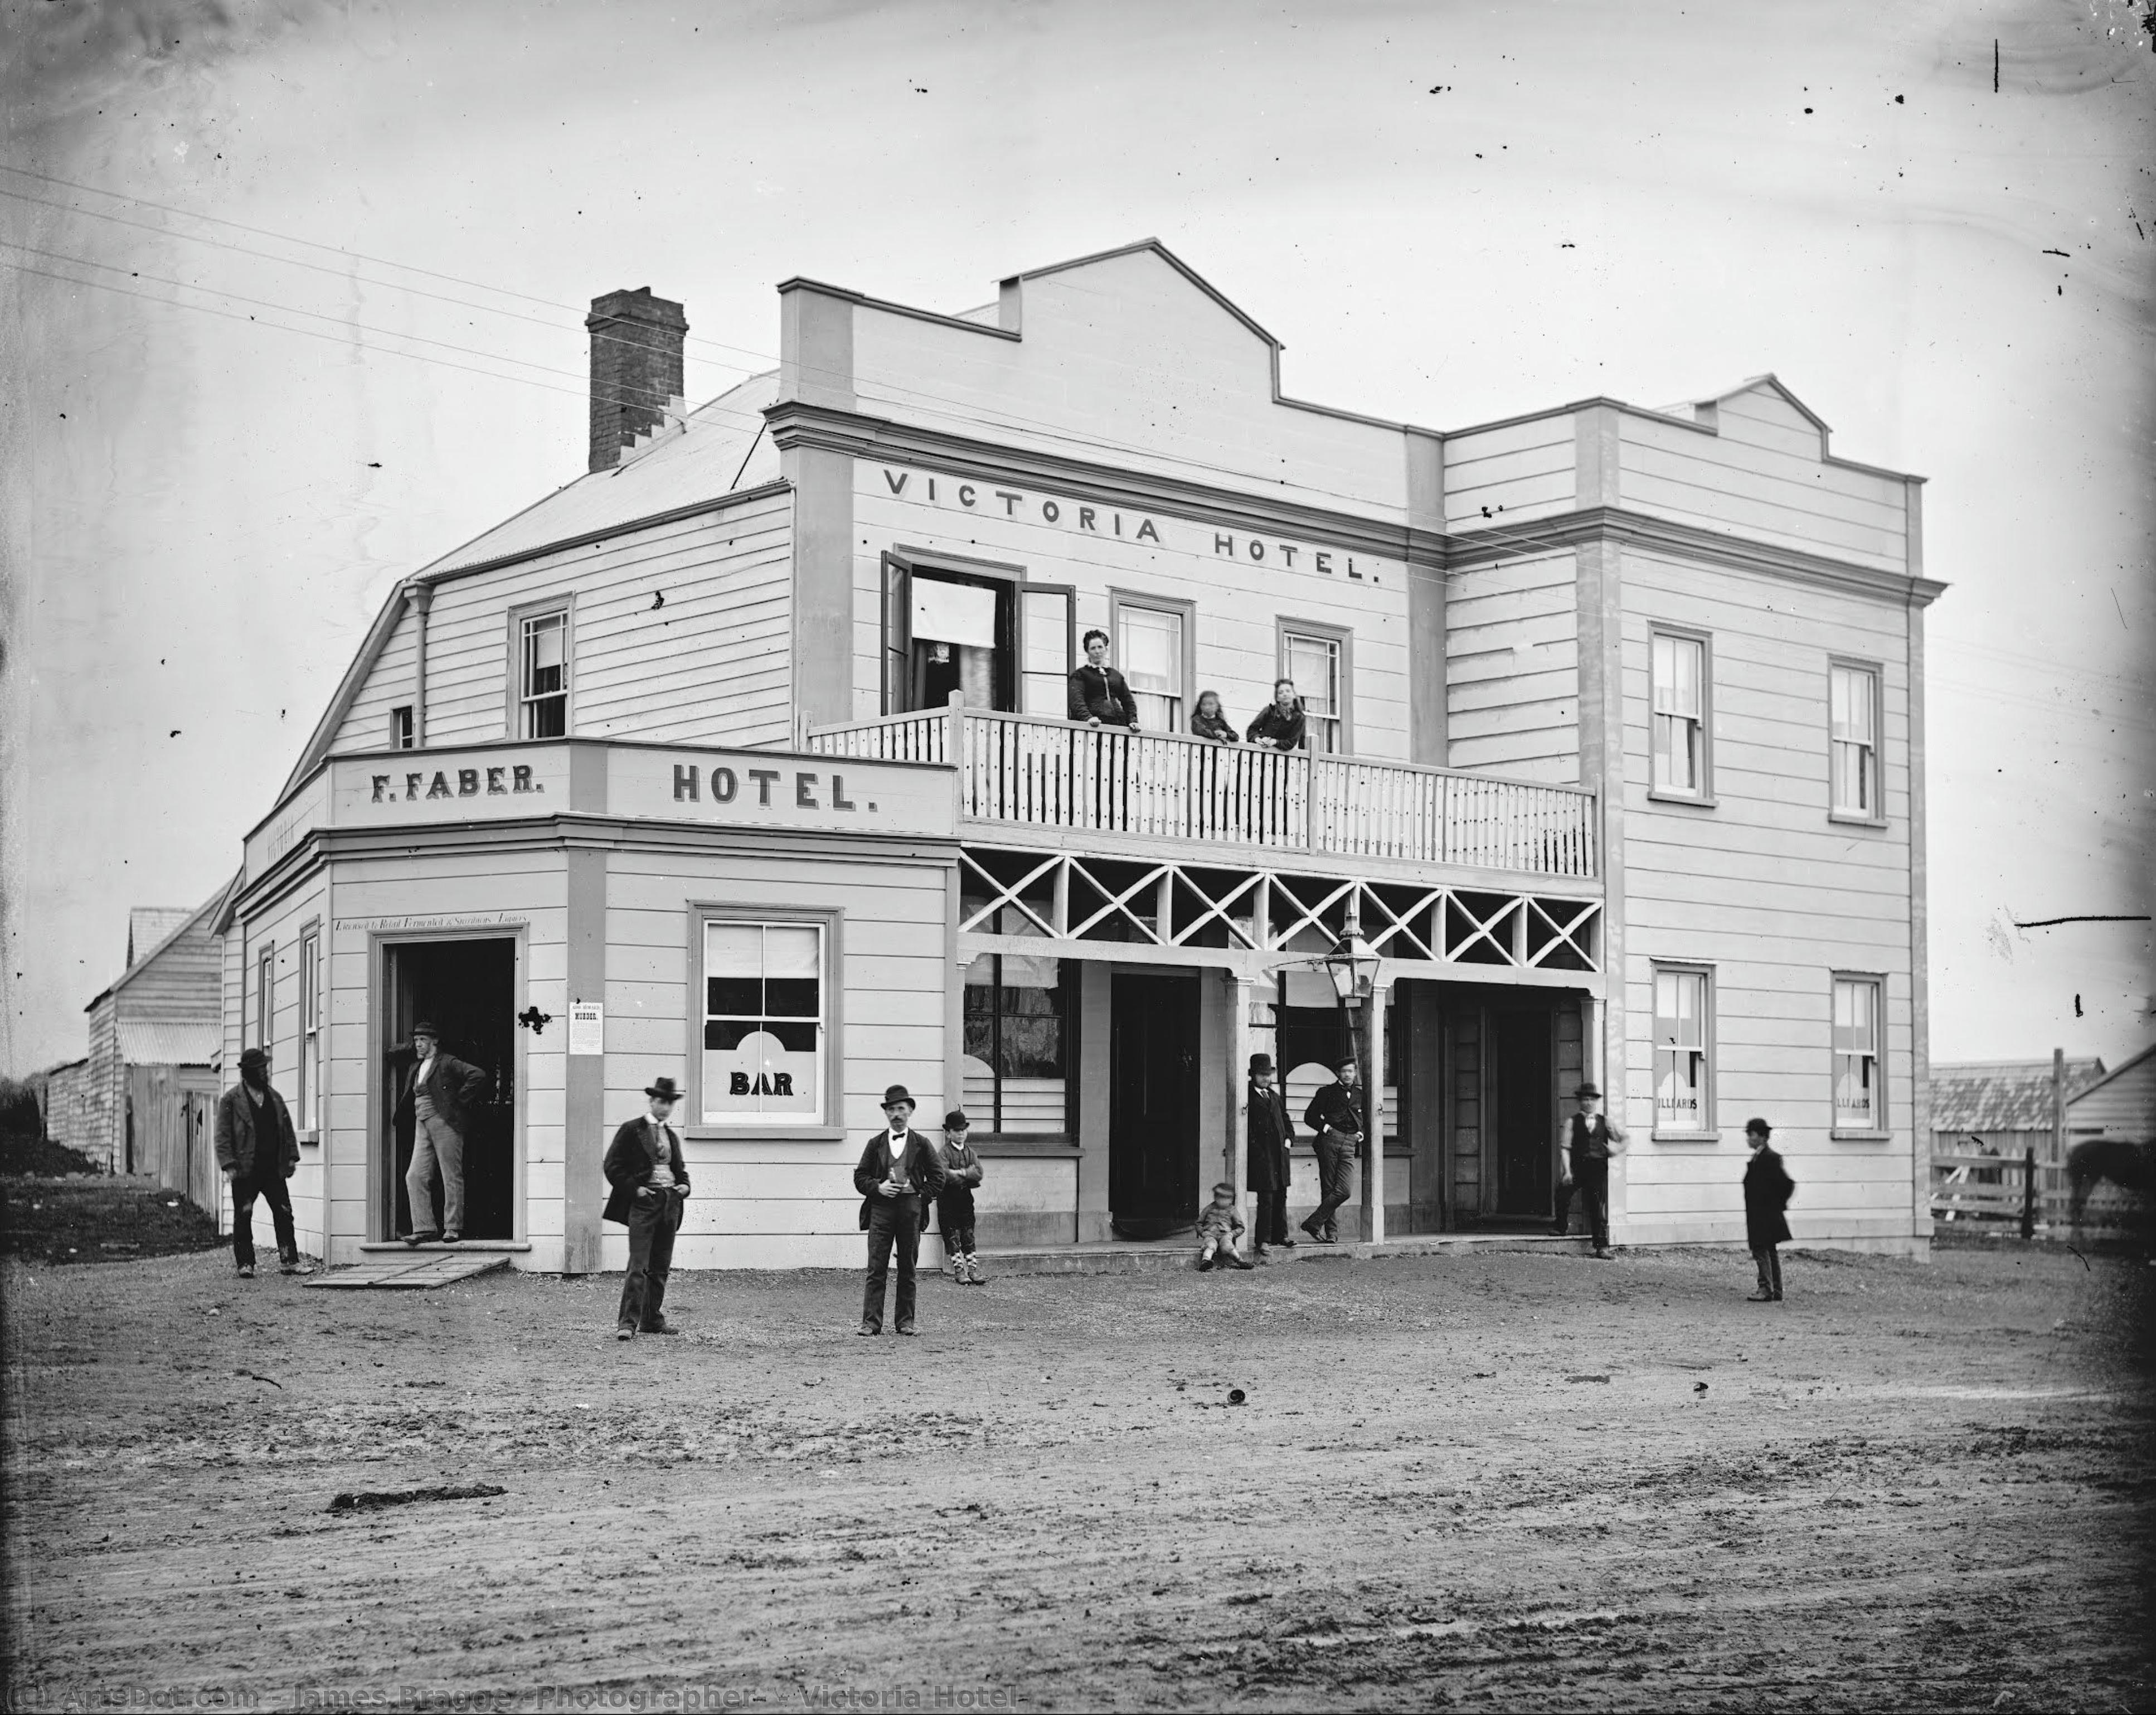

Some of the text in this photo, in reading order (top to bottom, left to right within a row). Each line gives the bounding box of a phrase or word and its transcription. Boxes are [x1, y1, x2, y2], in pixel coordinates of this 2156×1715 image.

[883, 469, 1379, 583] VICTORIA HOTEL.
[406, 765, 544, 801] FABER.
[674, 764, 877, 812] HOTEL.
[730, 1072, 793, 1096] BAR
[1658, 1098, 1697, 1110] ILLIARDS
